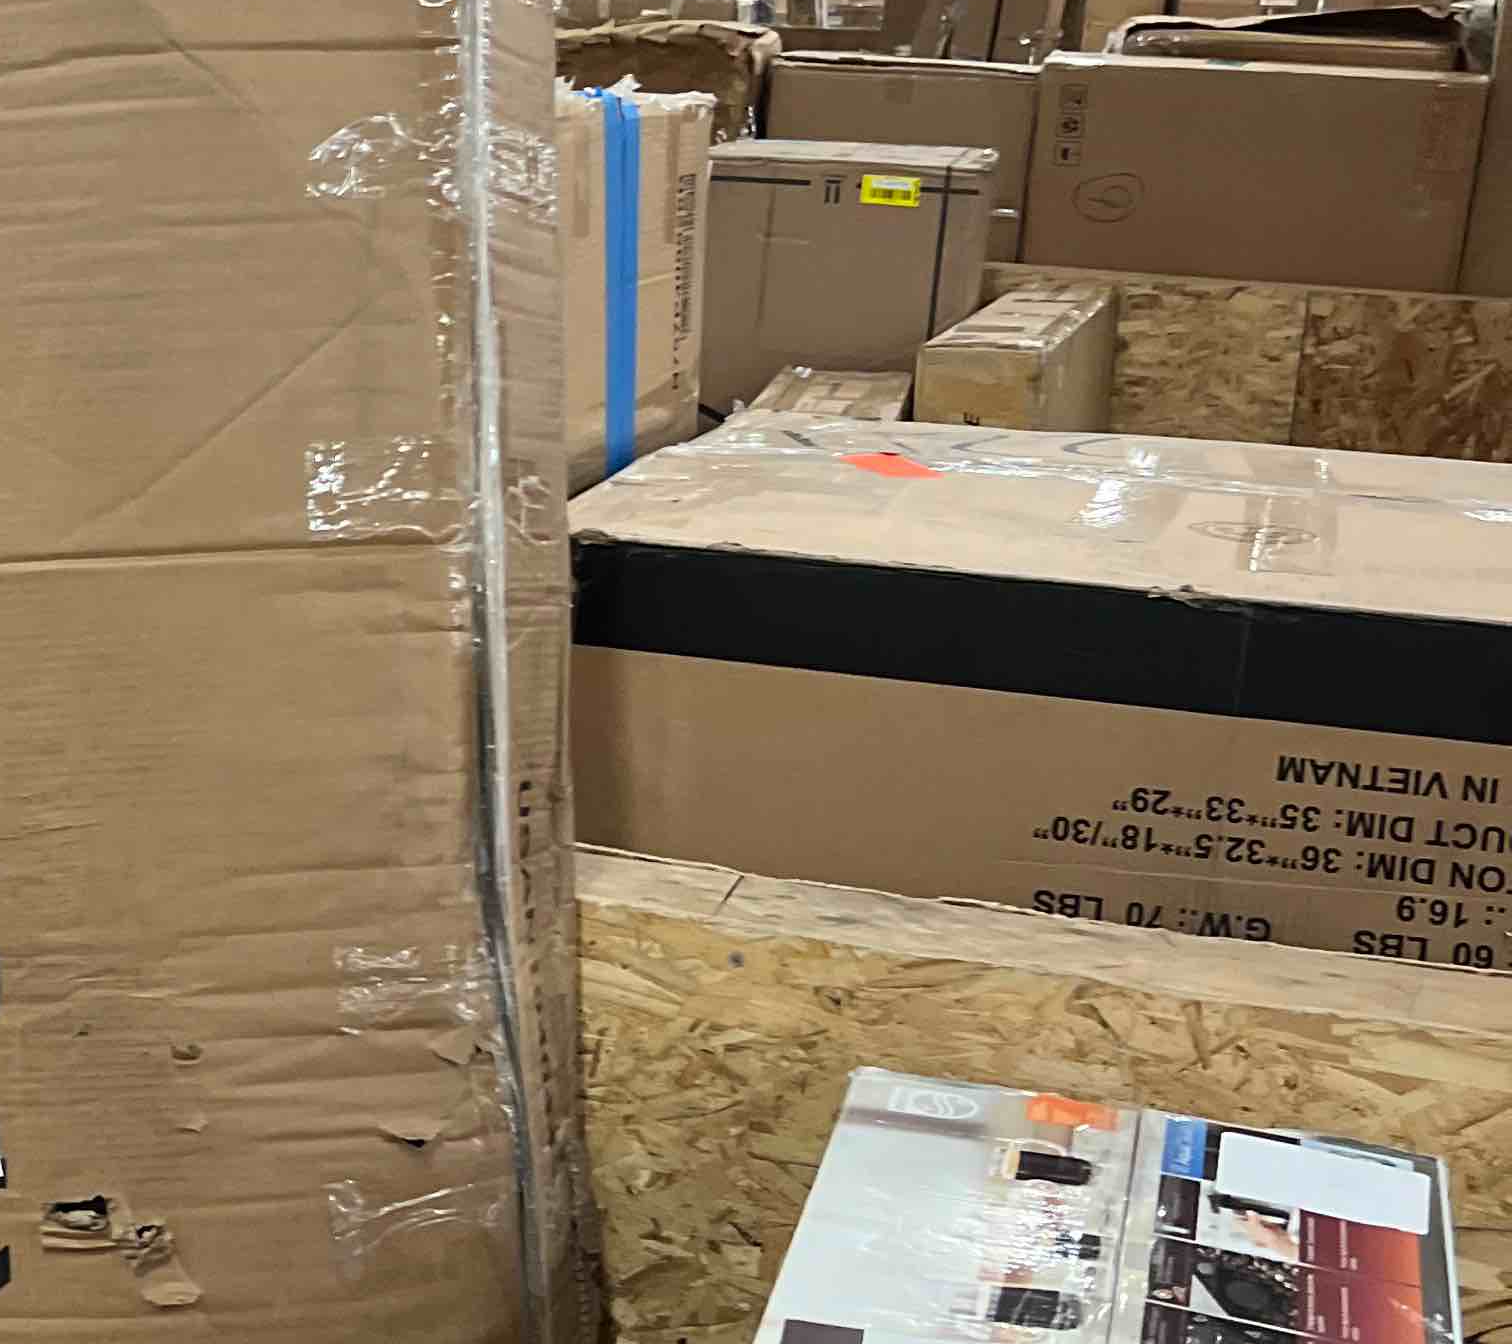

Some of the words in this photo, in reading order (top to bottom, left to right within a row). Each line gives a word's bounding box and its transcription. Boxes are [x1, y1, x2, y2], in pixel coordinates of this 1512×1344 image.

[1275, 755, 1448, 801] VIETNAM
[1462, 774, 1499, 804] IN
[1335, 810, 1413, 844] DIM:
[1425, 821, 1512, 855] UCT
[1356, 851, 1434, 886] DIM:
[1031, 889, 1104, 922] LBS
[1125, 902, 1164, 929] 70
[1396, 895, 1468, 929] 16.9
[1353, 930, 1428, 960] LBS
[1453, 943, 1494, 969] 60
